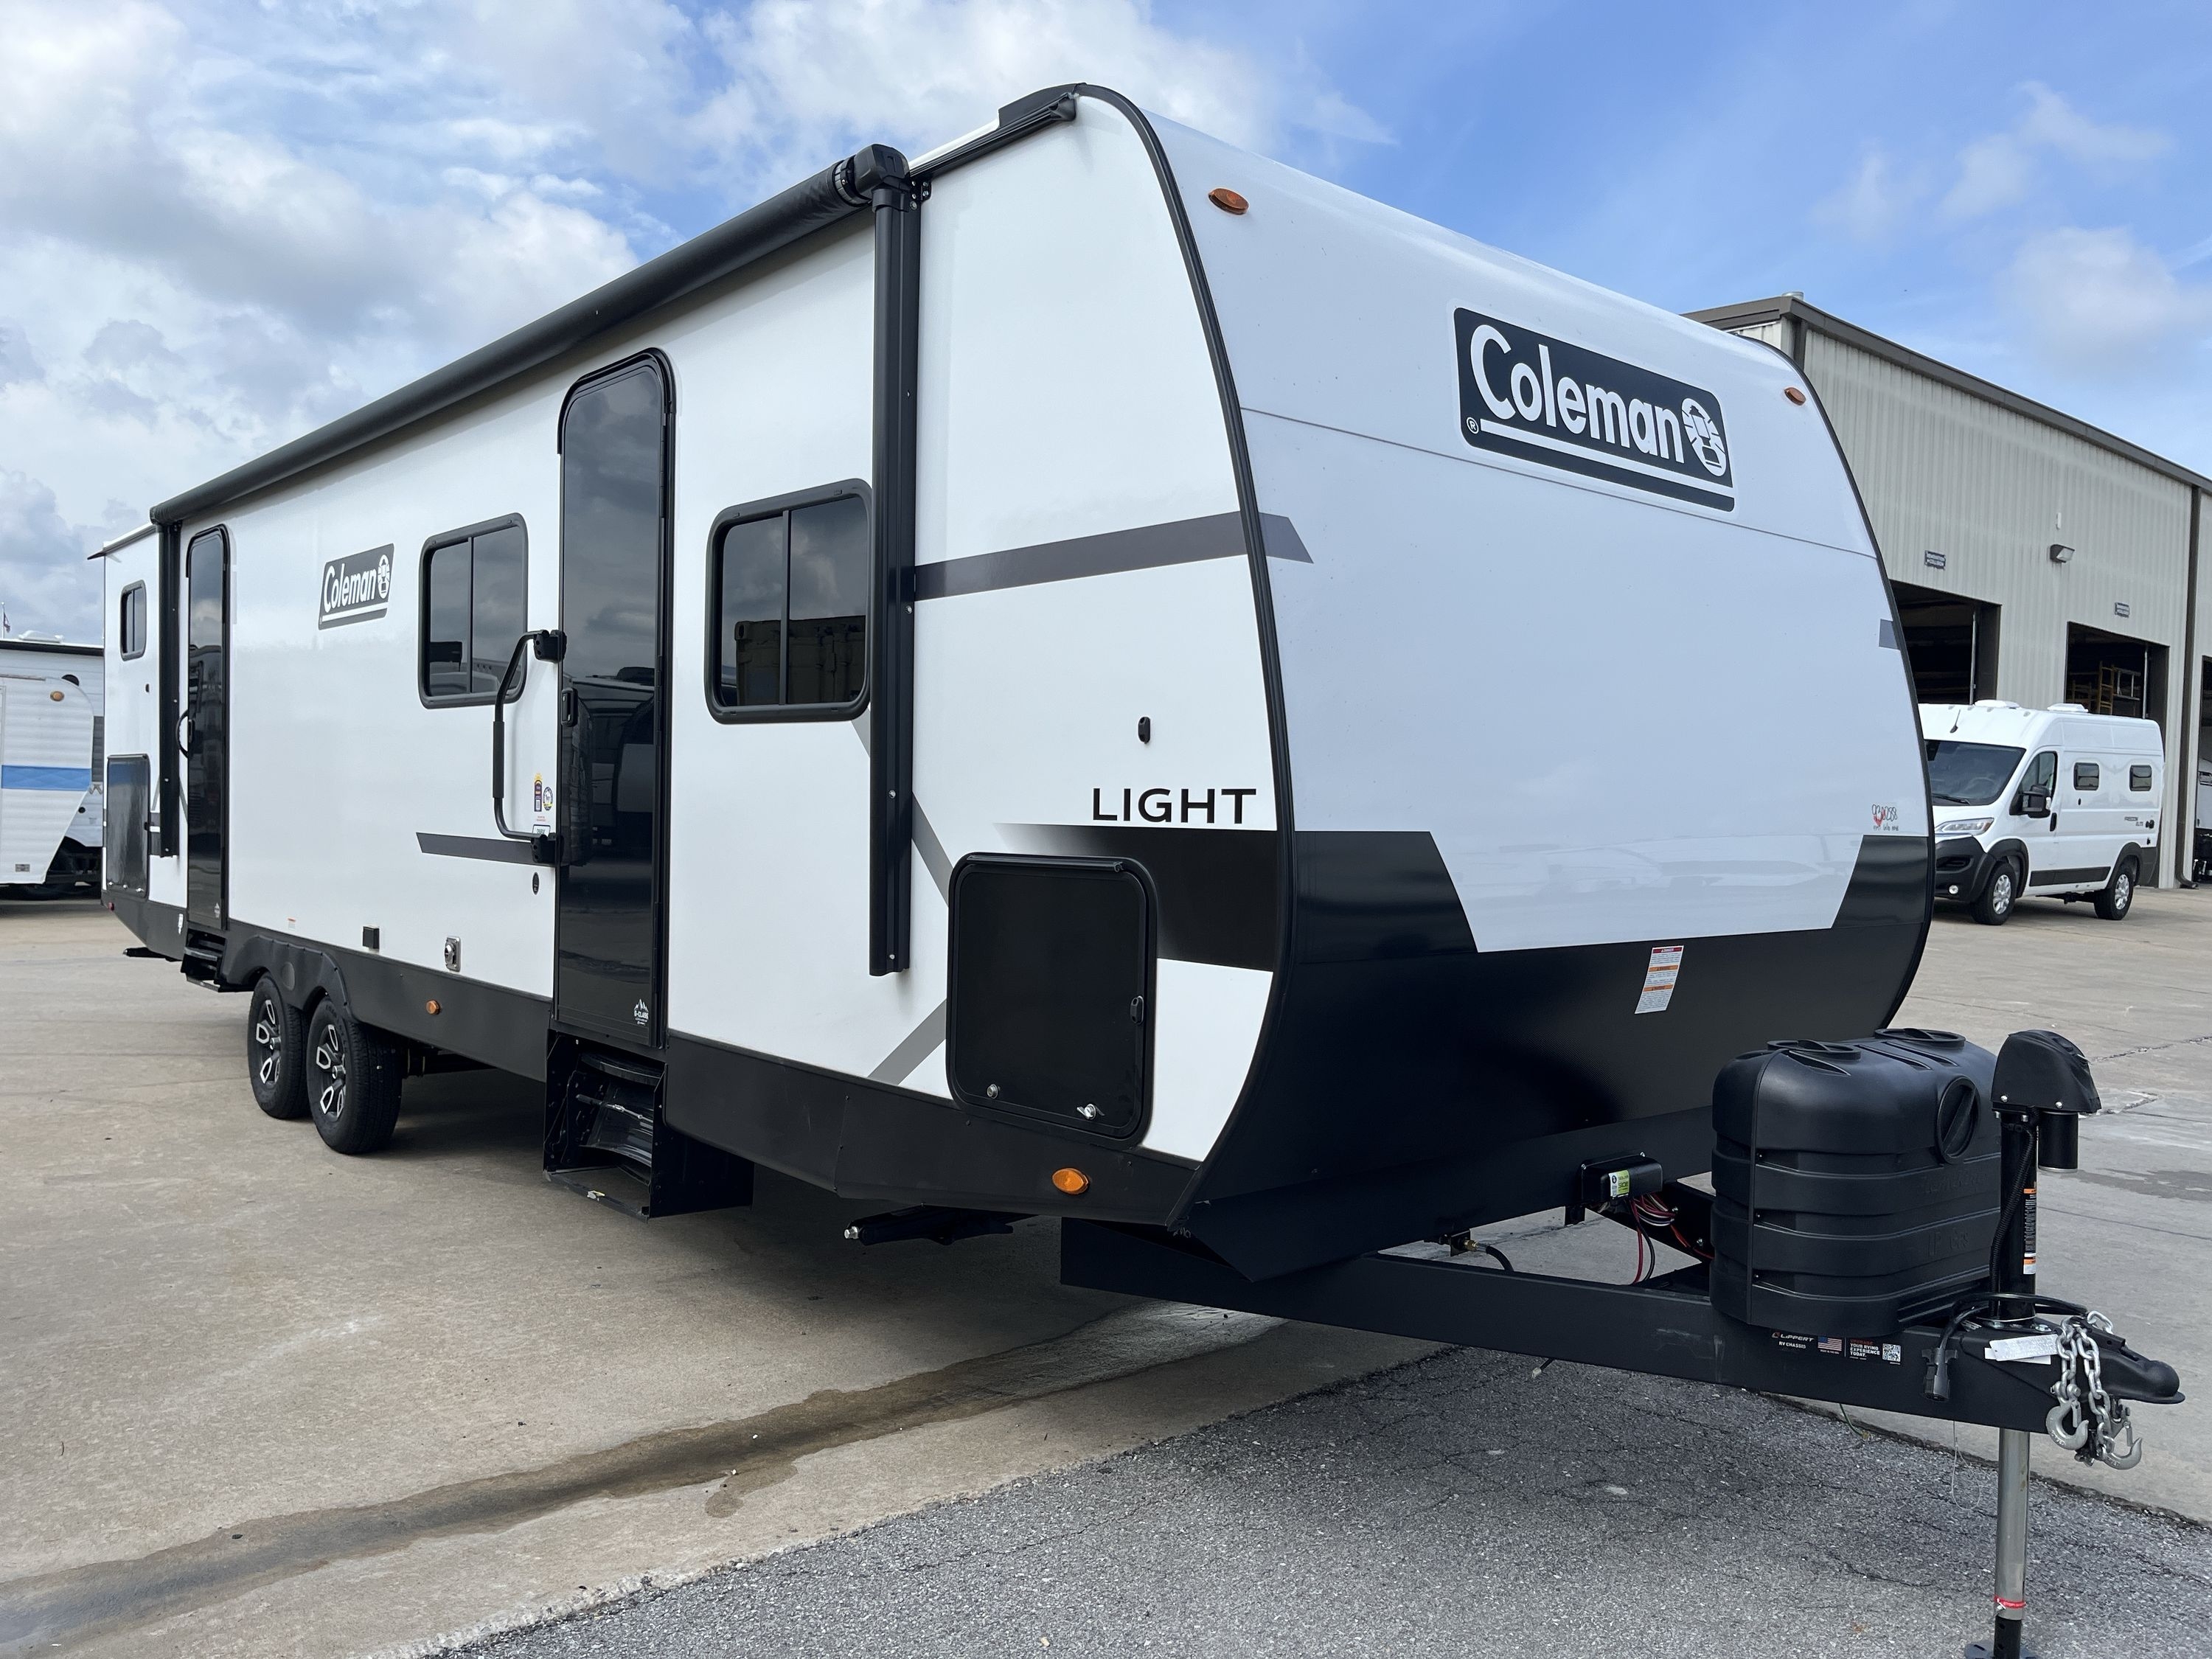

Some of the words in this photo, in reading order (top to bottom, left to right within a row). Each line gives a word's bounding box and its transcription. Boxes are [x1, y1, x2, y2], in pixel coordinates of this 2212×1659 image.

[1470, 324, 1684, 464] Coleman
[324, 563, 377, 613] Coleman
[1093, 788, 1256, 824] LIGHT
[1780, 1334, 1815, 1342] LIPPERT
[1850, 1347, 1880, 1355] EXPERIENCE
